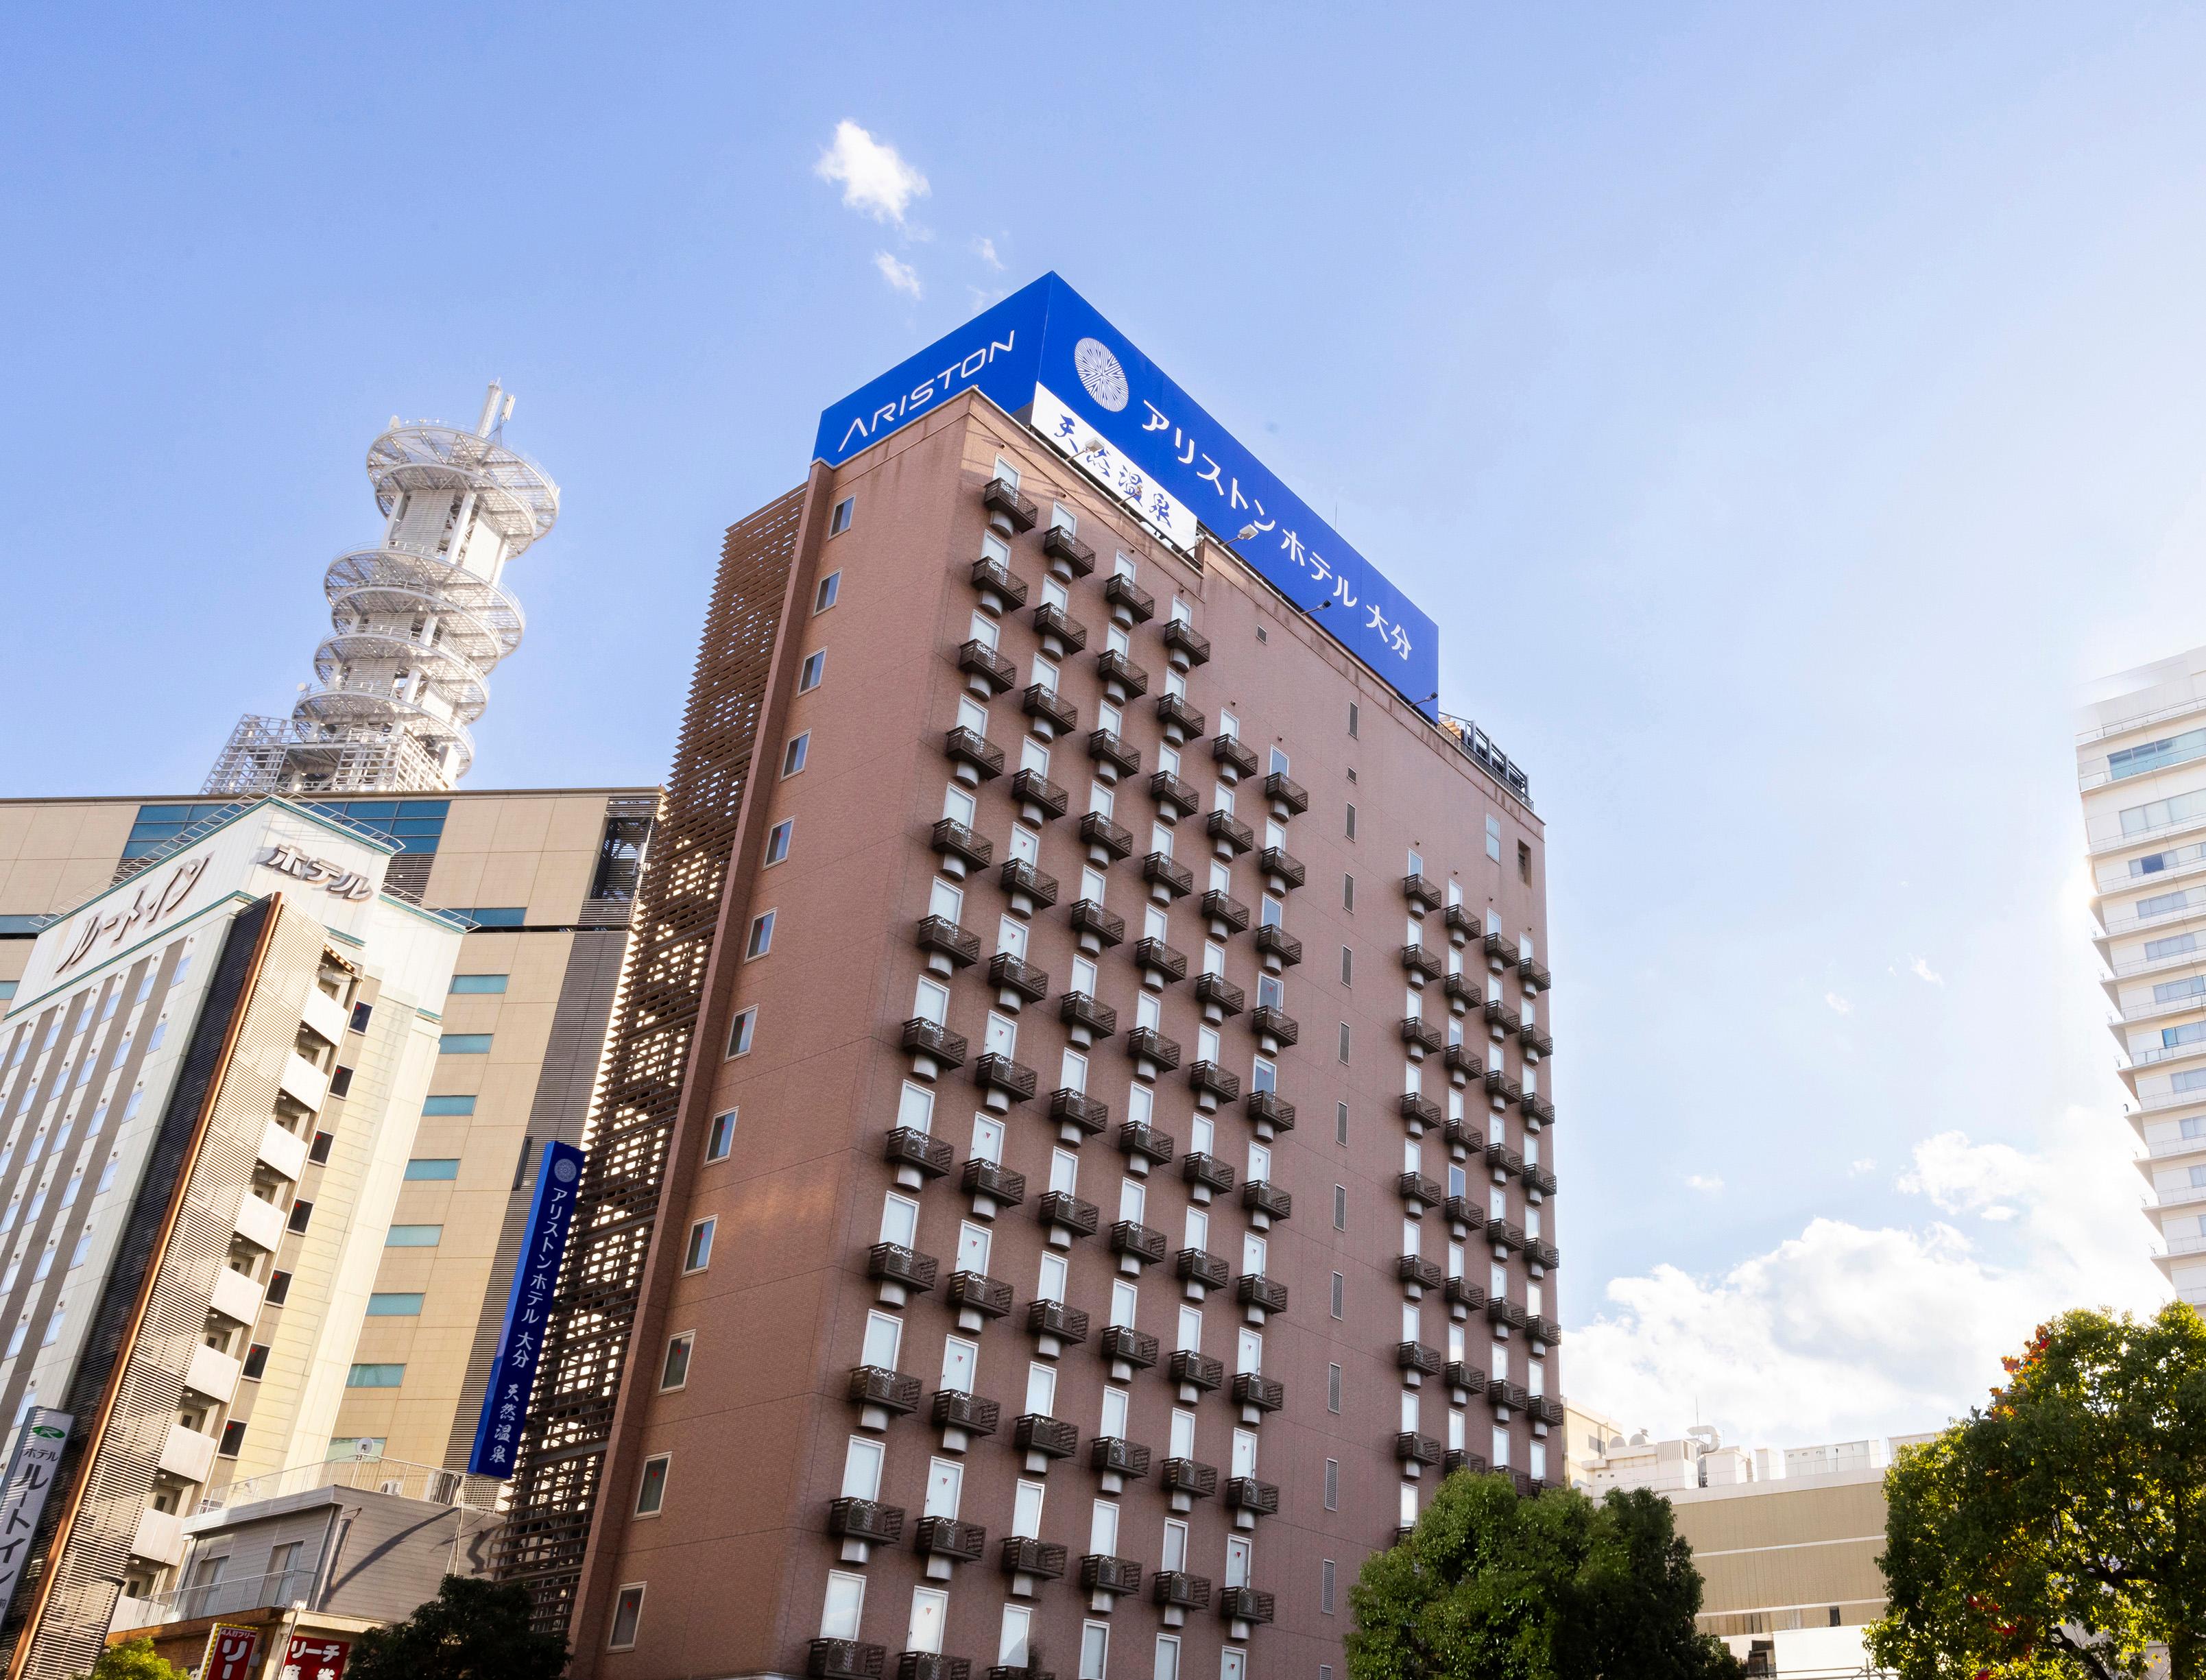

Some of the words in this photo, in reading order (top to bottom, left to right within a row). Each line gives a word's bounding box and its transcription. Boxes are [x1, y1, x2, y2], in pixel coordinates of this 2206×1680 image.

[837, 330, 1015, 453] ARISTON
[267, 845, 373, 902] ホテル
[53, 852, 214, 978] ルートイン
[23, 1448, 59, 1462] ホテル
[489, 1383, 520, 1463] 天然温泉
[291, 1640, 340, 1662] リーチ
